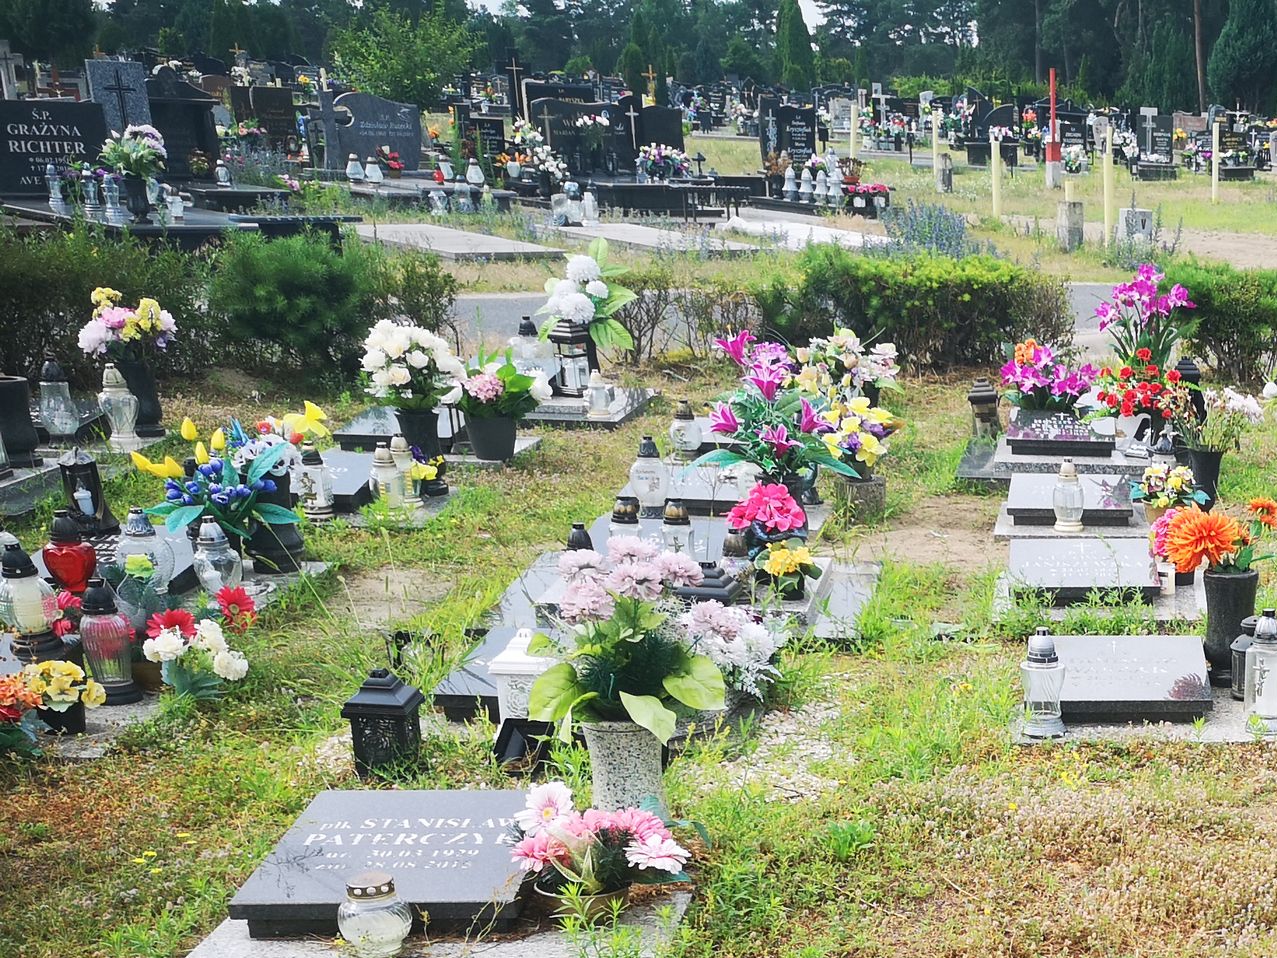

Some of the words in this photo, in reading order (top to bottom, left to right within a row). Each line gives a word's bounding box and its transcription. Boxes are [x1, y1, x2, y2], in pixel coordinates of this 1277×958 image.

[32, 108, 52, 120] Ś.P.
[7, 122, 82, 137] GRAŻYNA
[8, 141, 86, 154] RICHTER
[19, 176, 42, 185] AVE
